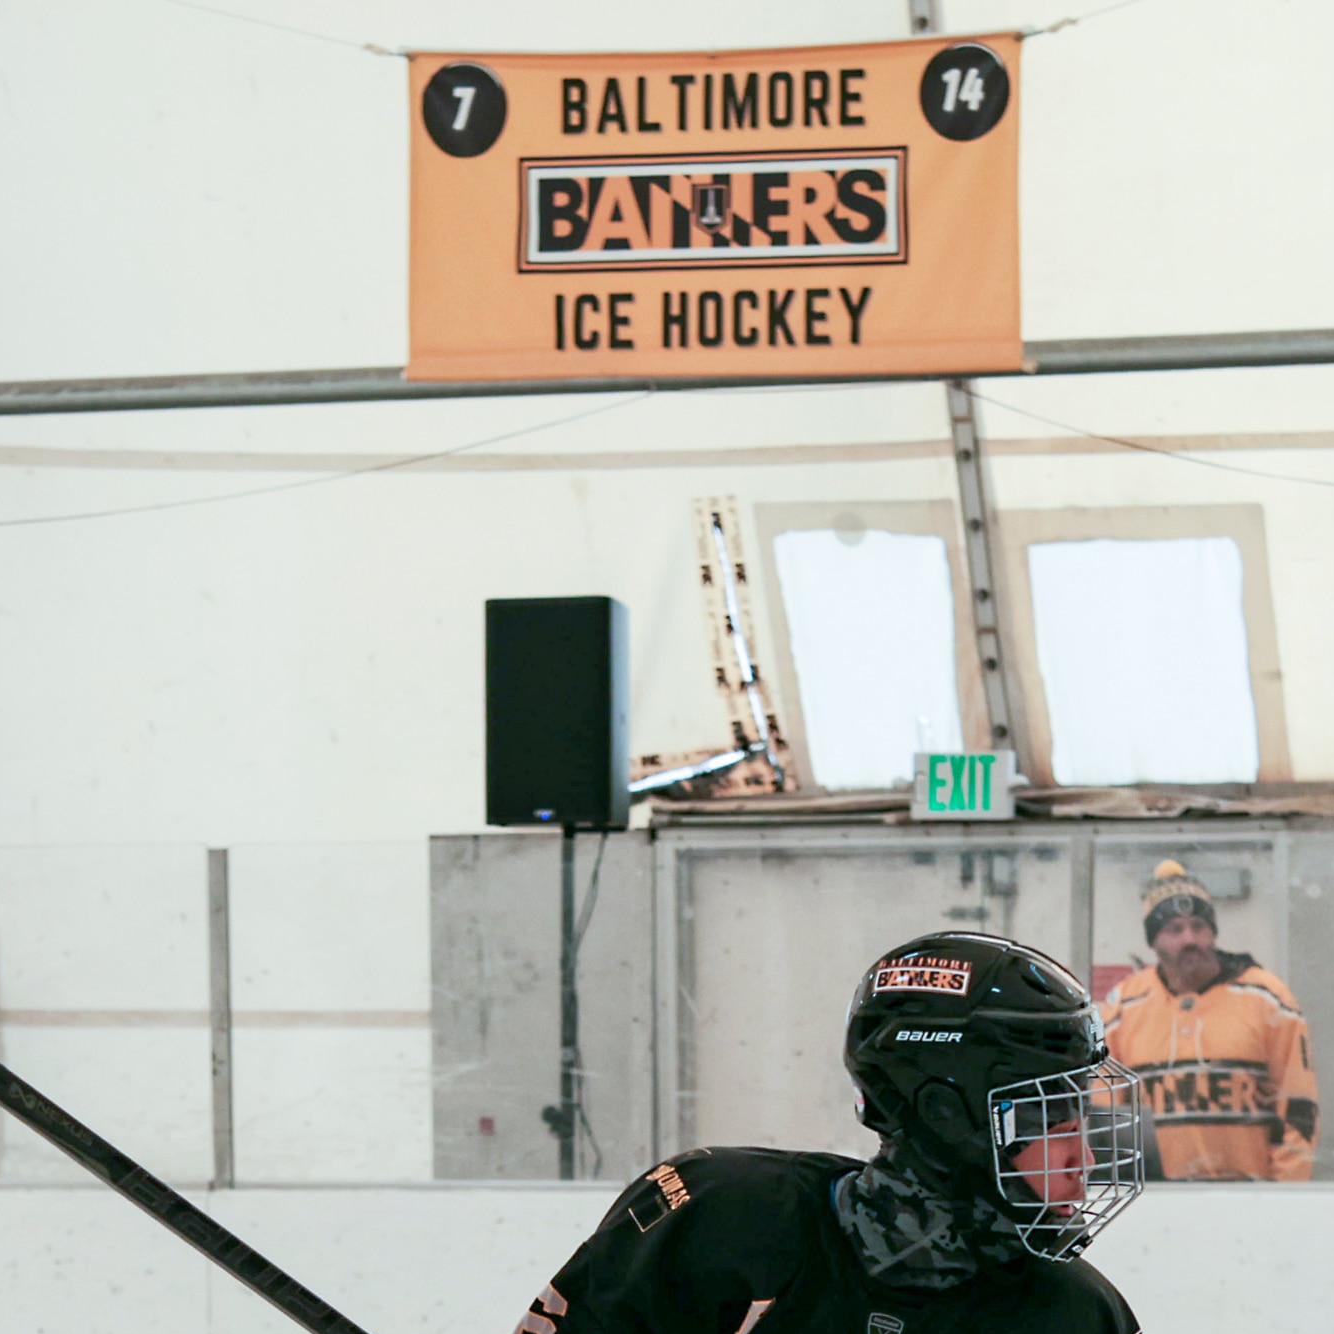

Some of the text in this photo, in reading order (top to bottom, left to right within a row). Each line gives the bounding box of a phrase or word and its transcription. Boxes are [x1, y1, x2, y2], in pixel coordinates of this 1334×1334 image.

[451, 87, 476, 131] 7
[562, 69, 867, 135] BALTIMORE
[941, 68, 986, 113] 14
[555, 286, 873, 352] ICE HOCKEY
[929, 754, 996, 812] EXIT
